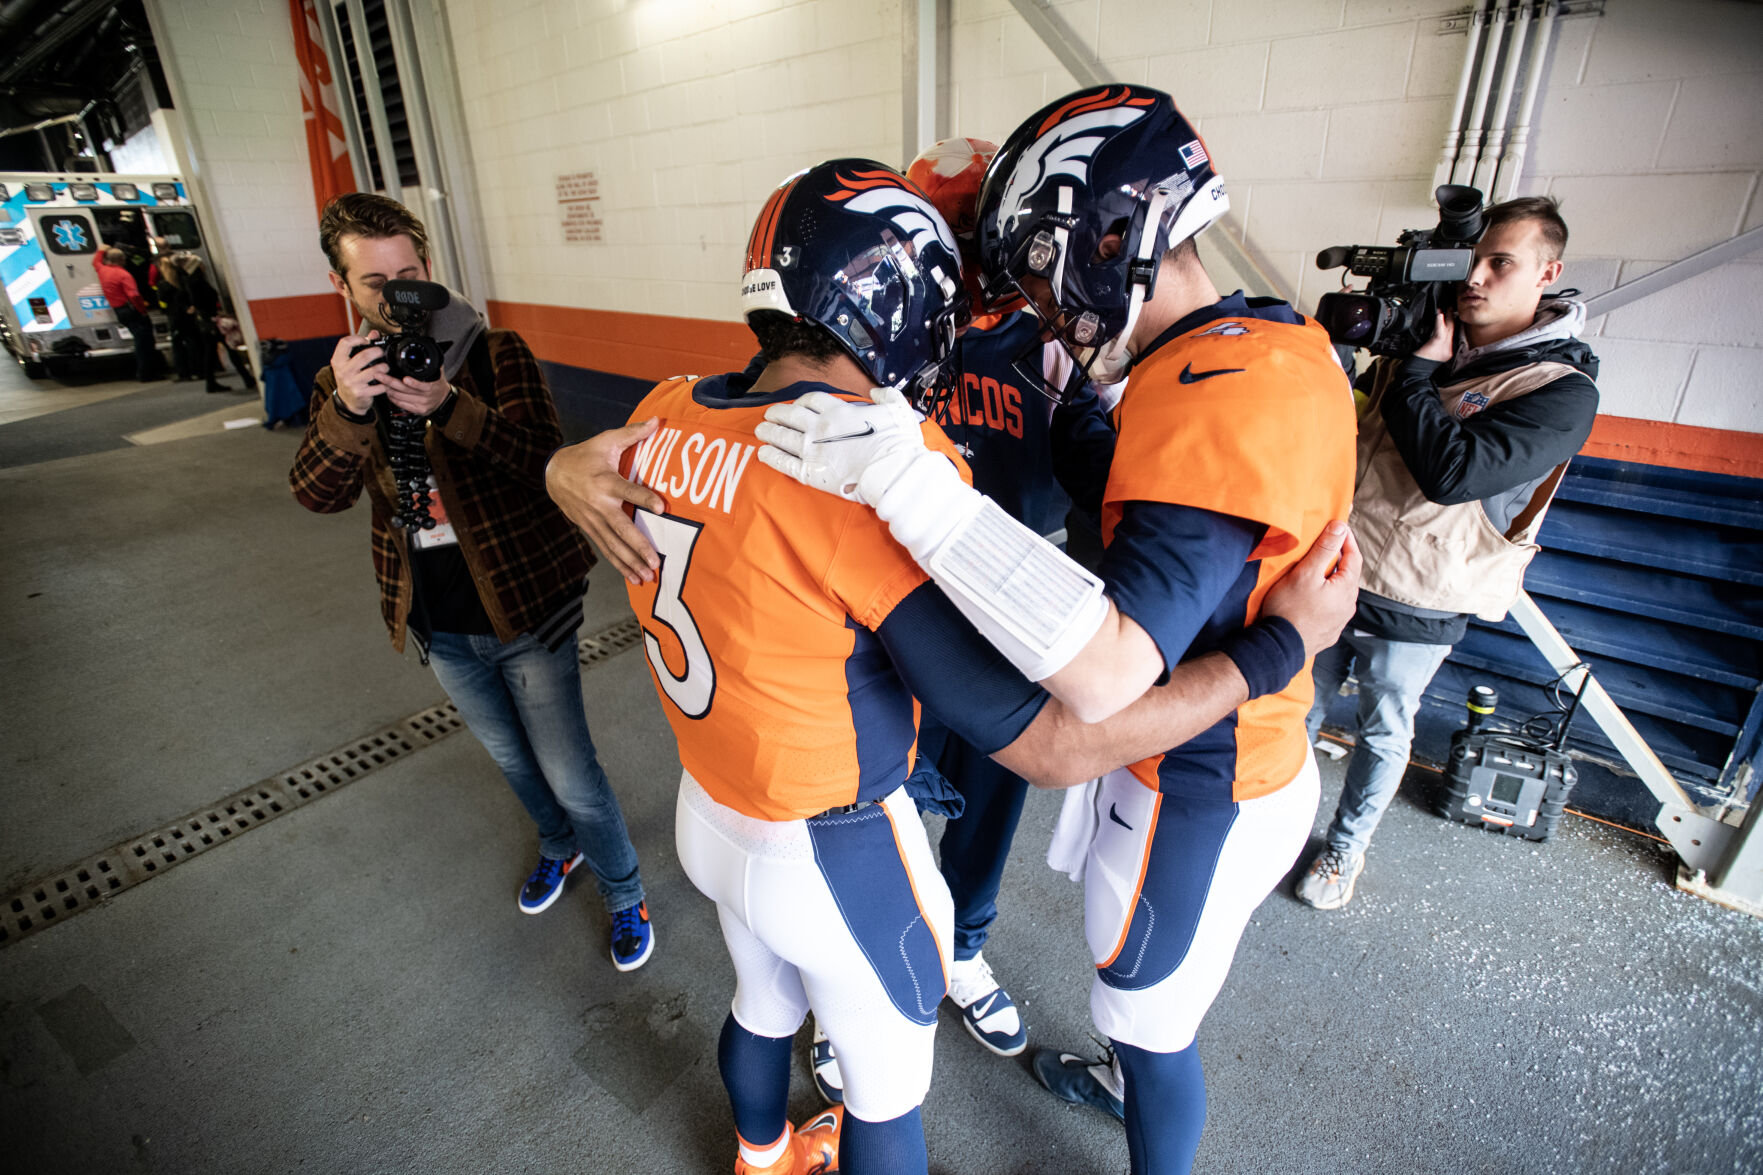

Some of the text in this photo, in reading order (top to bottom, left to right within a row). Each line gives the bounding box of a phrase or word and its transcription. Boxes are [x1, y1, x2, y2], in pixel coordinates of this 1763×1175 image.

[780, 246, 792, 267] 3
[757, 281, 775, 291] LOVE
[628, 427, 755, 514] WILSON
[634, 504, 717, 720] 3
